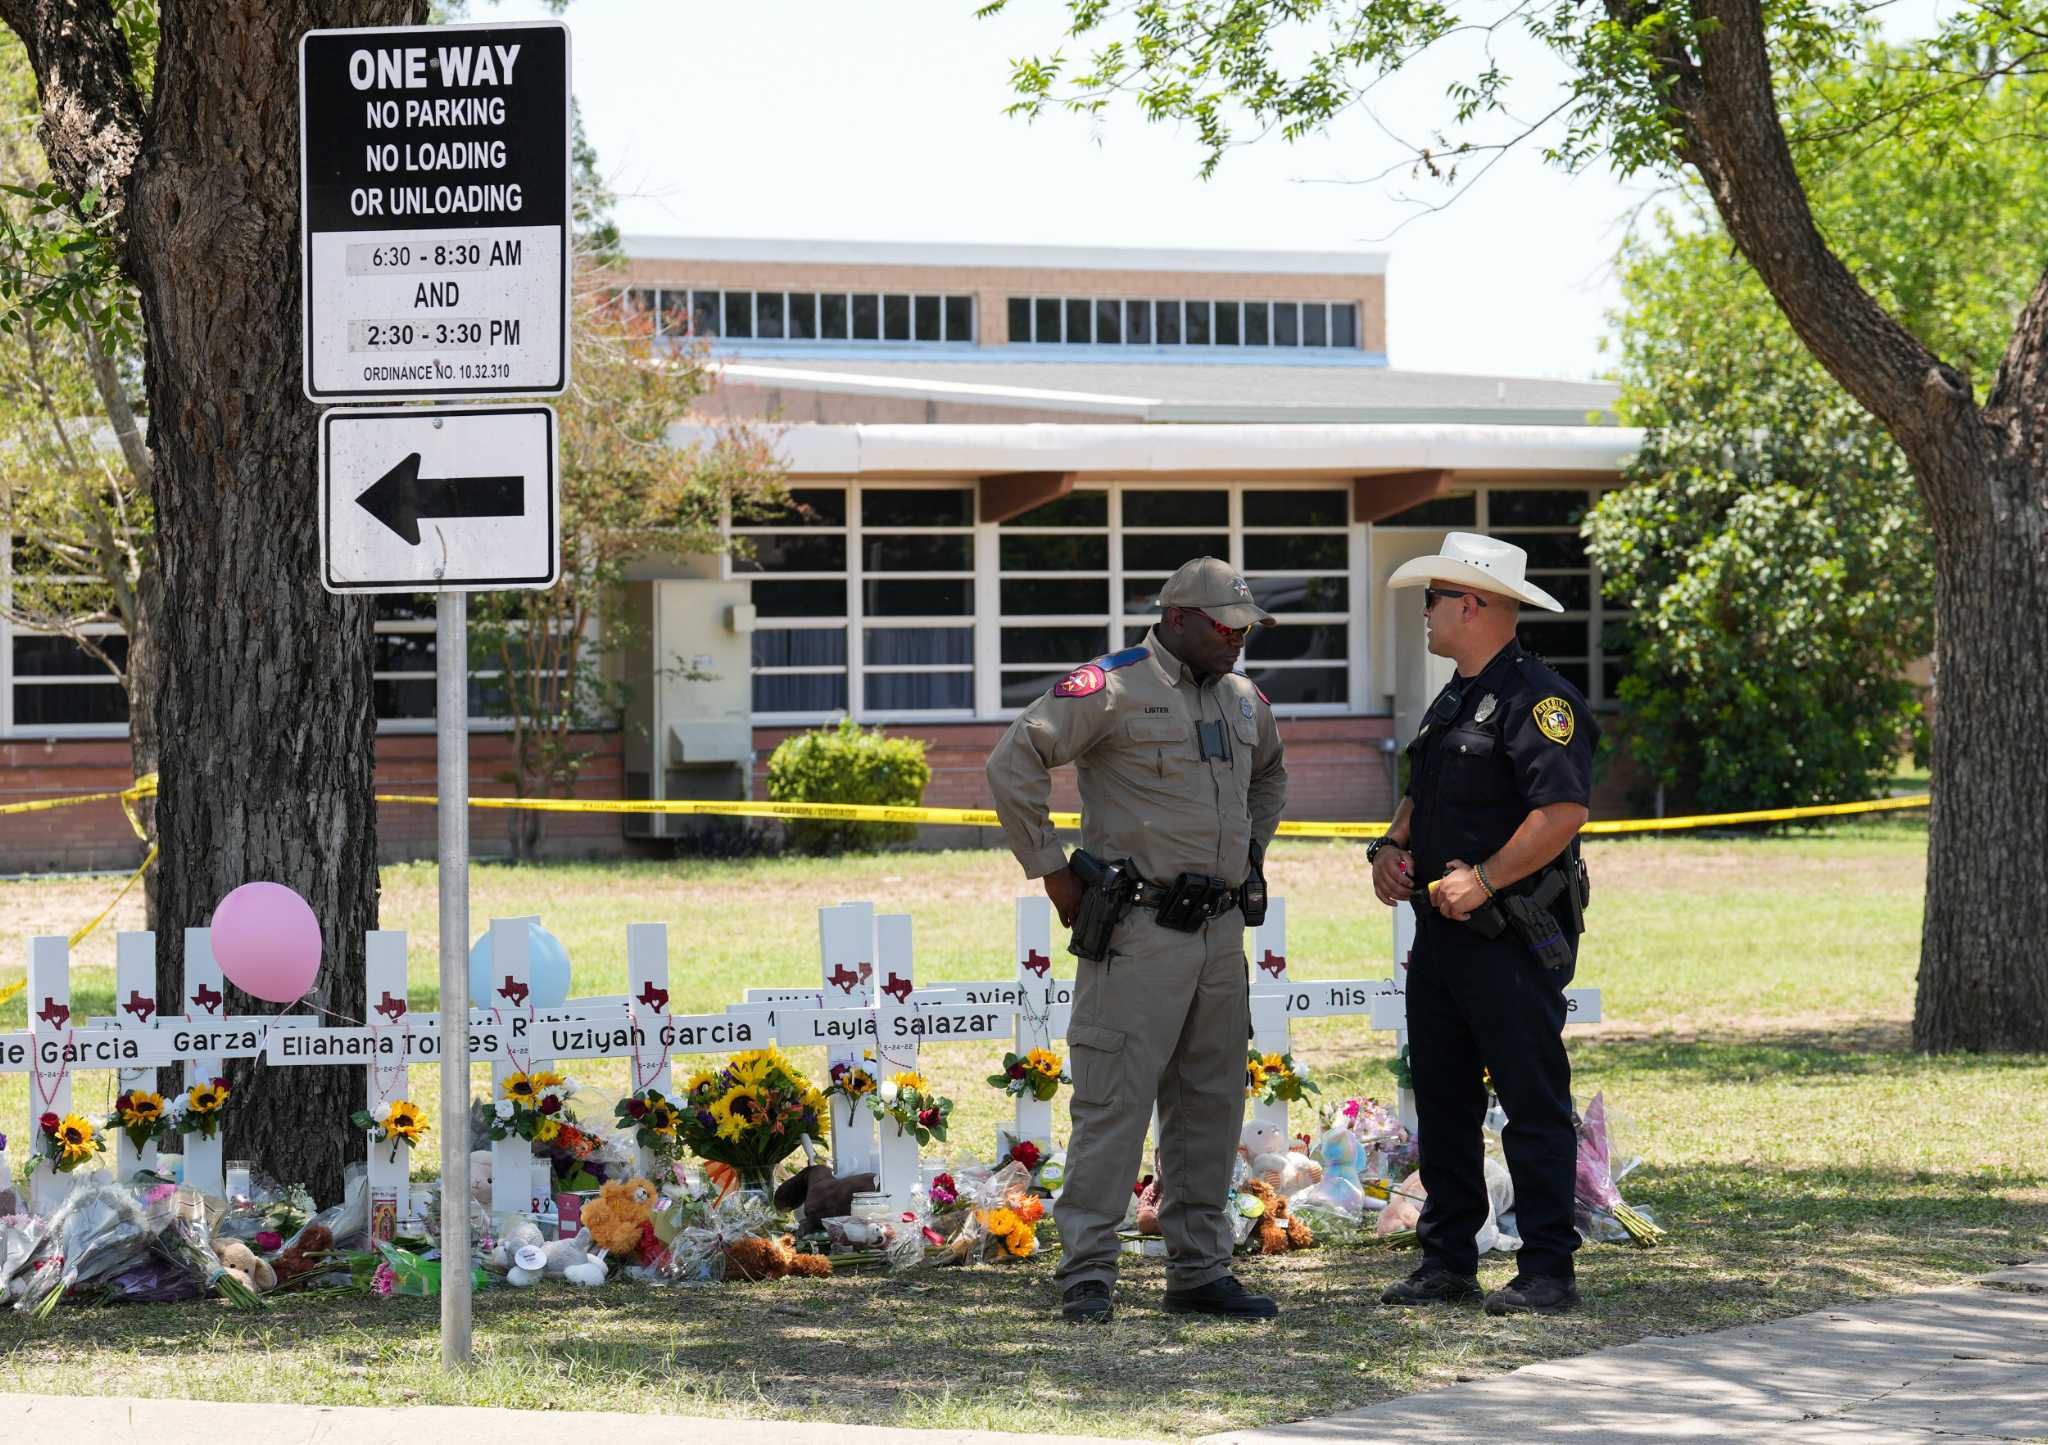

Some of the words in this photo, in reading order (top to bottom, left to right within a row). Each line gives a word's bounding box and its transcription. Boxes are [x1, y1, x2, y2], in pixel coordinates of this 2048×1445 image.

[350, 48, 428, 90] ONE
[438, 45, 521, 87] WAY
[366, 101, 399, 128] NO
[406, 97, 506, 127] PARKING
[366, 144, 399, 172] NO
[406, 141, 507, 171] LOADING
[350, 188, 384, 216] OR
[390, 184, 522, 215] UNLOADING
[372, 247, 411, 267] 6:30
[434, 245, 480, 265] 8:30
[489, 240, 522, 266] AM
[414, 282, 460, 308] AND
[368, 325, 414, 346] 2:30
[436, 323, 482, 344] 3:30
[490, 320, 521, 346] PM
[363, 365, 433, 382] ORDINANCE
[436, 364, 456, 380] NO.
[459, 363, 510, 380] 10.32.310
[966, 988, 1025, 1005] avier
[552, 1026, 646, 1053] Uziyah
[659, 1022, 752, 1047] Garcia
[814, 1018, 877, 1040] Layla
[894, 1013, 999, 1036] Salazar
[41, 1038, 139, 1064] Garcia
[174, 1031, 257, 1051] Garza
[283, 1035, 393, 1056] Eliahana
[402, 1033, 498, 1054] Toes
